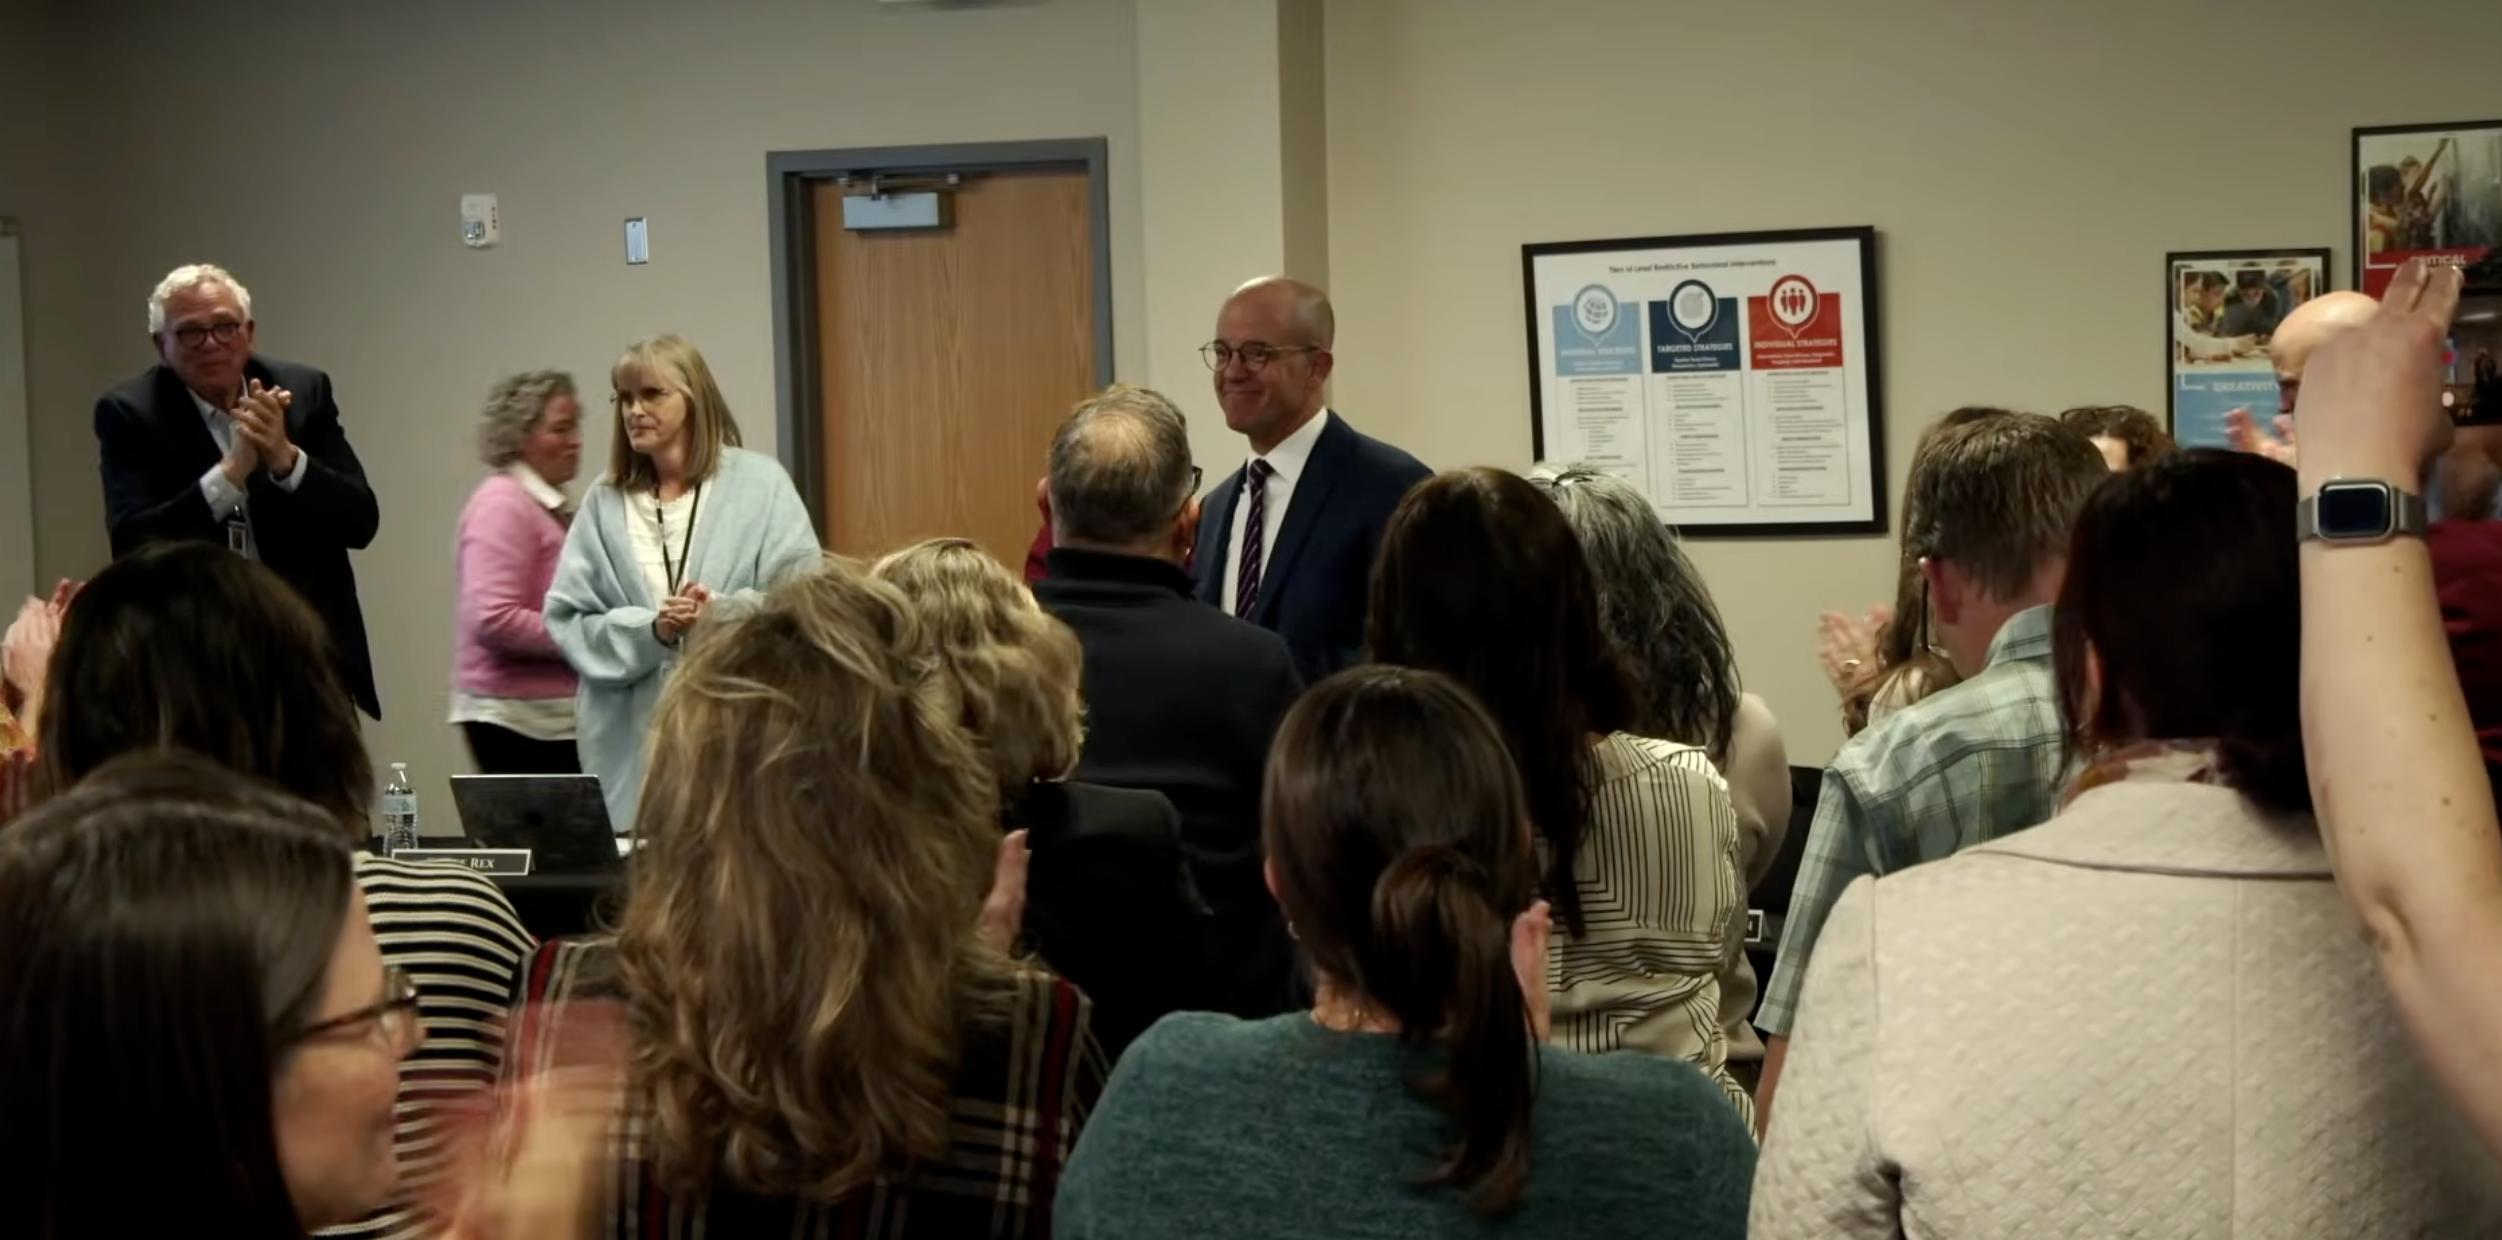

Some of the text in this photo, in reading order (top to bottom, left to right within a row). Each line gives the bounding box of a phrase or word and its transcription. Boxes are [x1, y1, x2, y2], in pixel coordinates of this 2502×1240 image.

[1797, 338, 1838, 347] STRATEGIES
[1657, 343, 1734, 353] TARGETED STRATEGIES
[470, 858, 495, 869] REX
